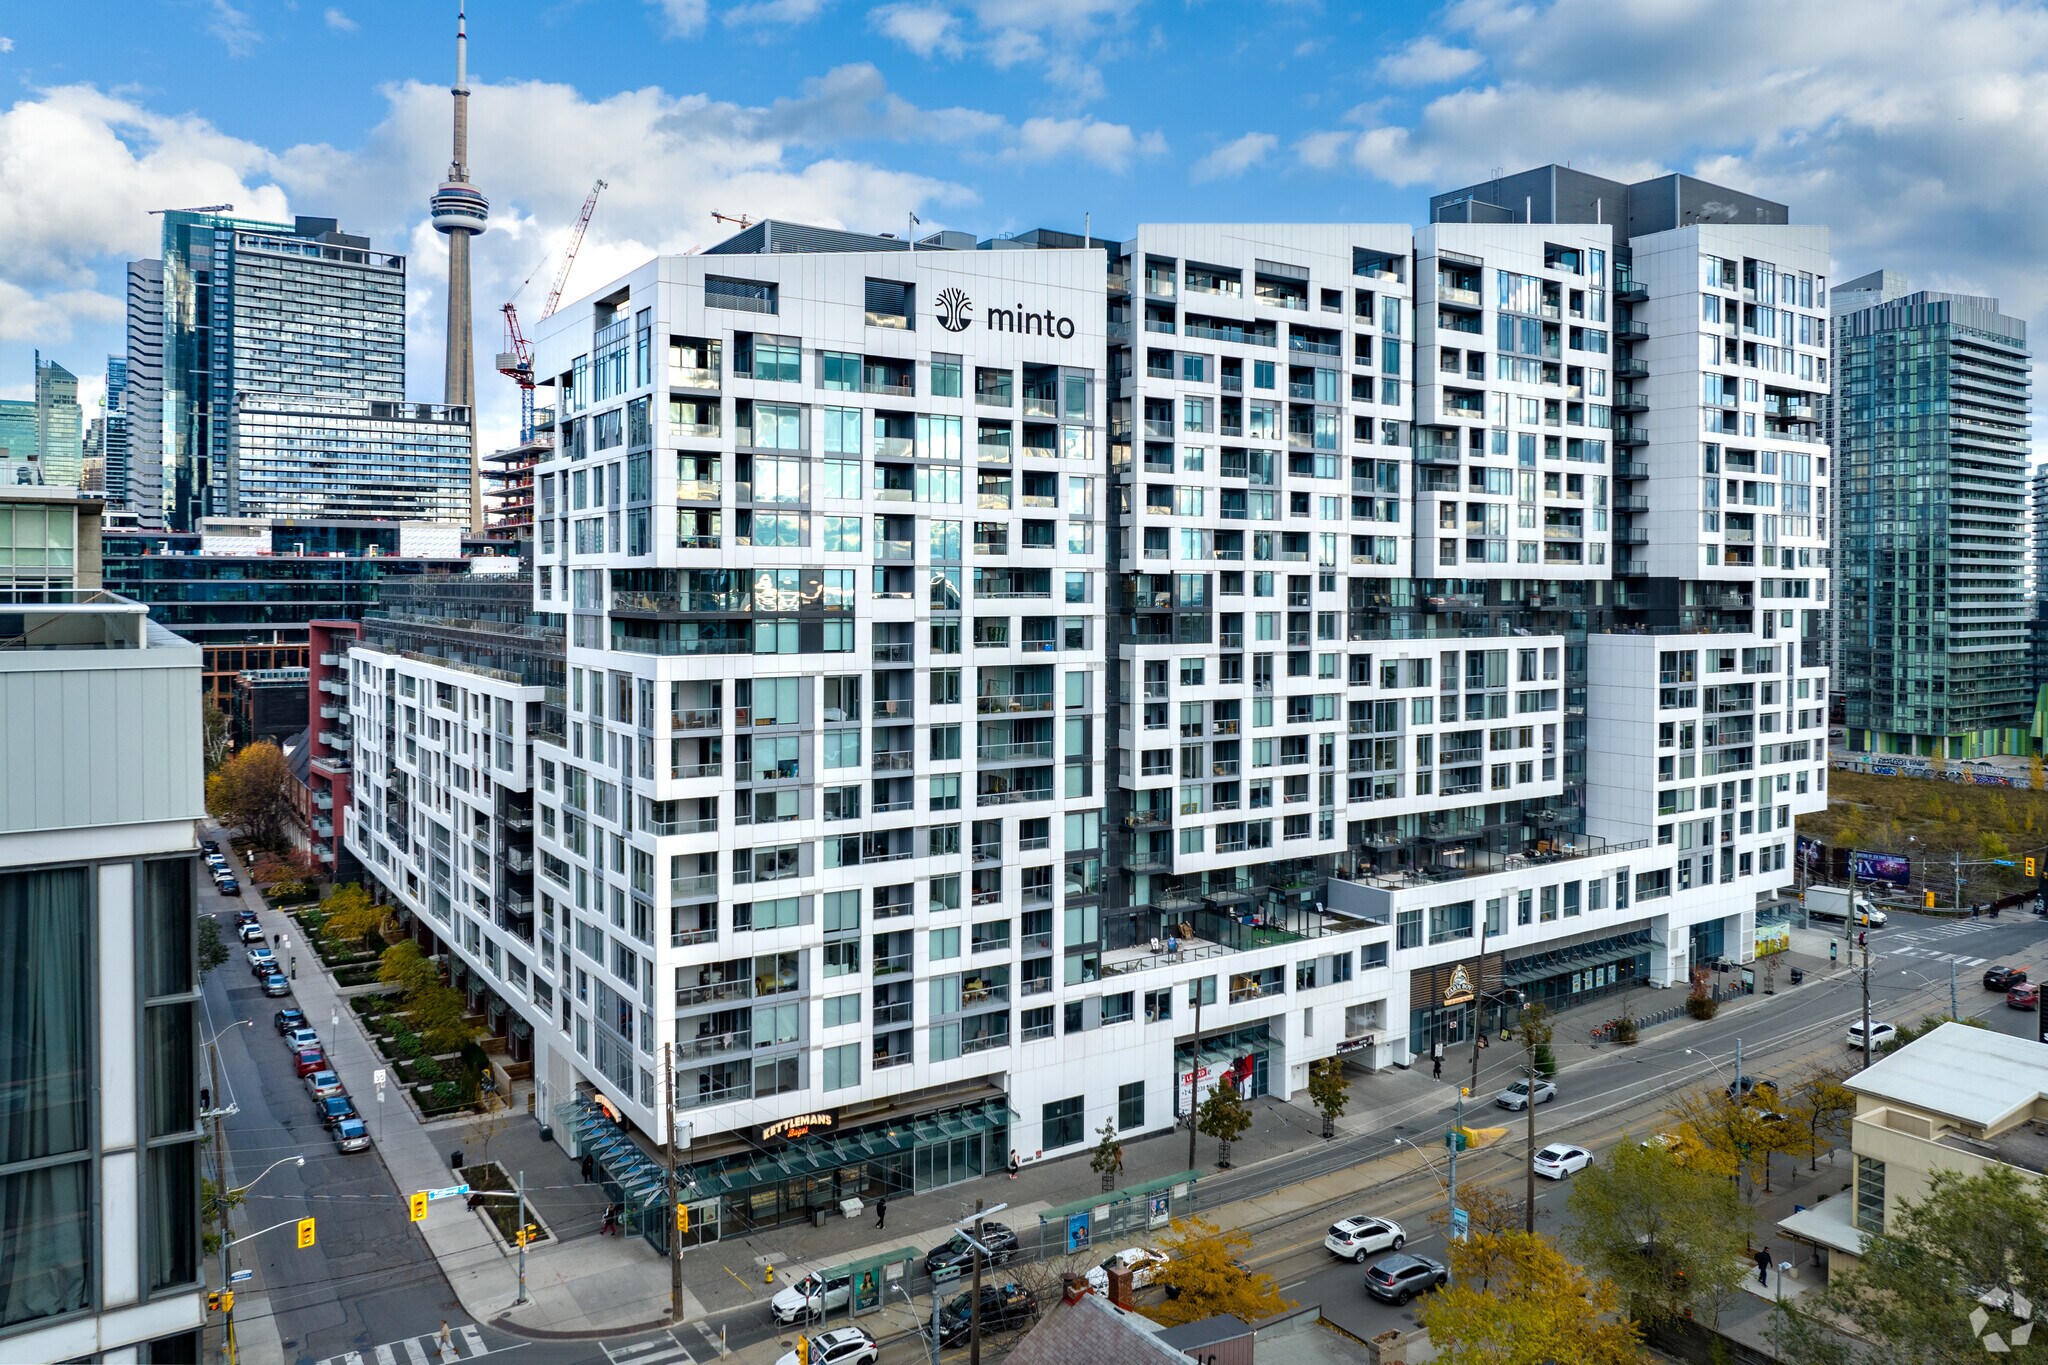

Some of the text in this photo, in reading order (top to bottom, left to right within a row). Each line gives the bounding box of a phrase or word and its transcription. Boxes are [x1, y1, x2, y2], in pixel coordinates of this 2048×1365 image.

[988, 303, 1075, 339] minto
[763, 1114, 832, 1140] KETTLEMANS
[787, 1126, 808, 1138] Bagel
